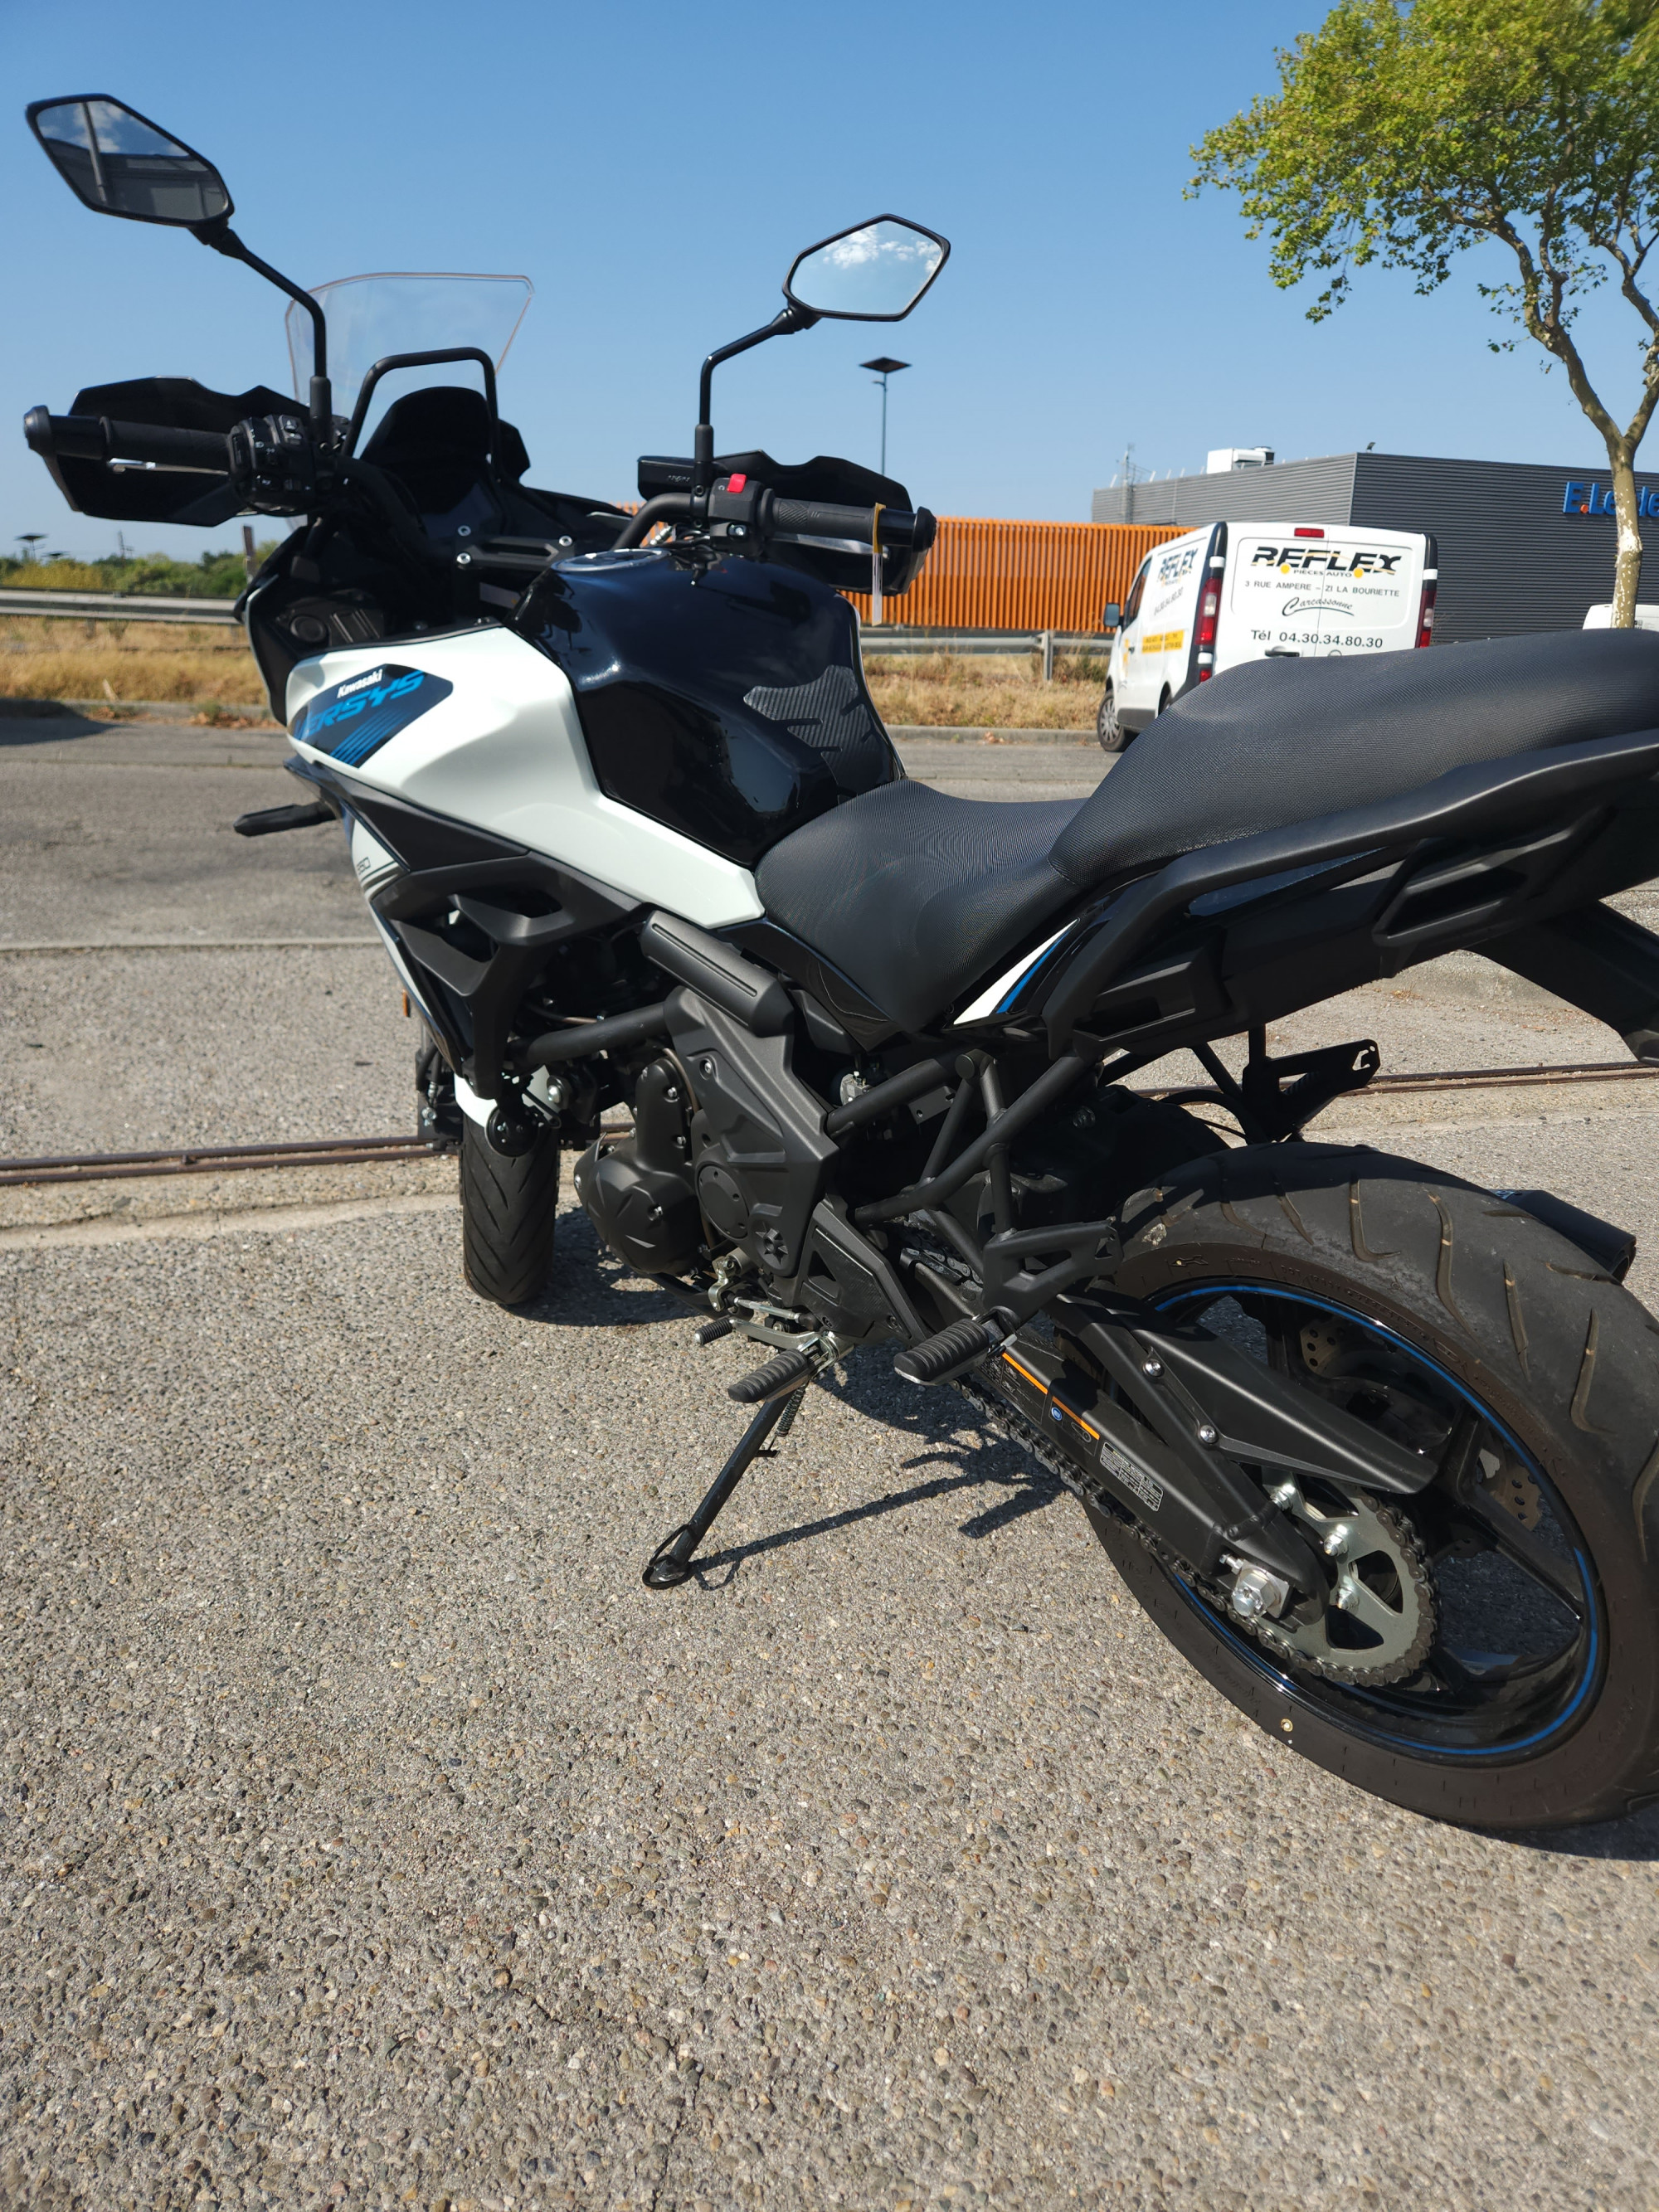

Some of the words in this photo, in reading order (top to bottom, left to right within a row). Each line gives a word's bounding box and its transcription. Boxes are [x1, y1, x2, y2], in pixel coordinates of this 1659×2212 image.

[1250, 546, 1402, 576] REFLEX
[1253, 581, 1272, 589] RUE
[1276, 581, 1311, 591] AMPERE
[1336, 586, 1348, 594] LA
[1352, 586, 1399, 597] BOURIETTE
[1282, 596, 1355, 616] Carcassonne
[1250, 630, 1271, 641] Tél
[1279, 631, 1383, 649] 04.30.34.80.30
[337, 668, 383, 698] Kawasaki
